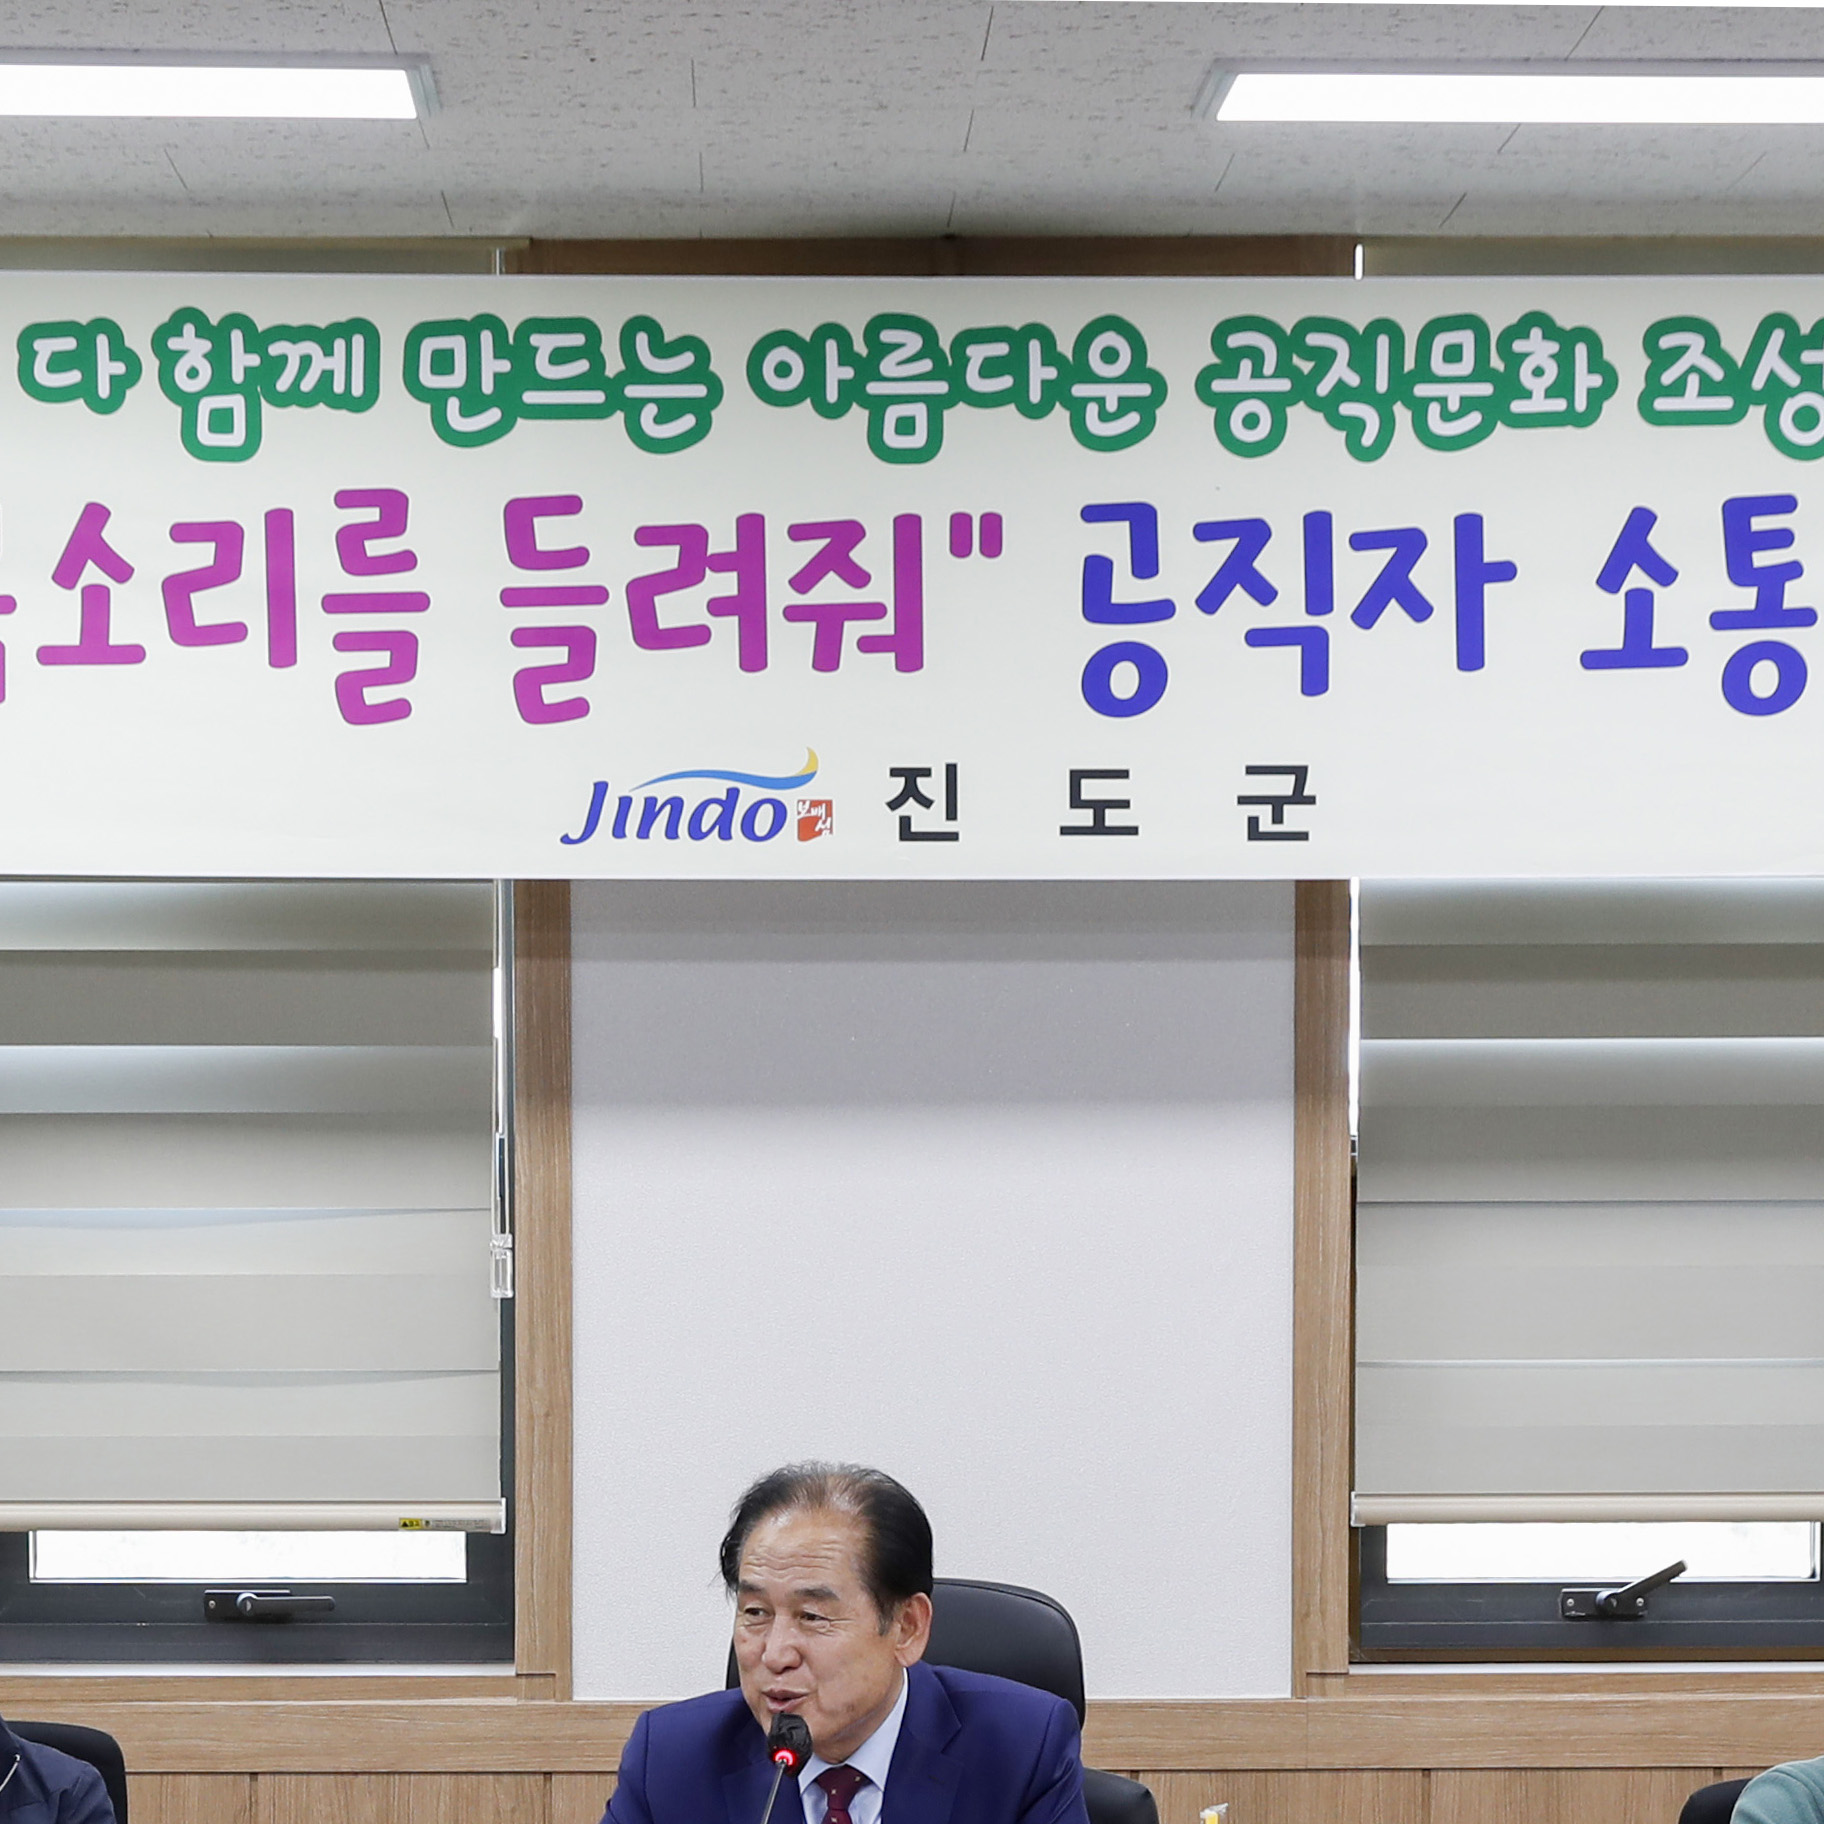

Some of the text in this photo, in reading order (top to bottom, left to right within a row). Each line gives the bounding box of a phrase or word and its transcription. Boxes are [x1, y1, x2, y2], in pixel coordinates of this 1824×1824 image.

[16, 316, 144, 417] 다
[150, 306, 382, 464] 함께
[402, 312, 725, 456] 만드는
[745, 312, 1169, 466] 아름다운
[1194, 310, 1620, 463] 공직문화
[499, 494, 1004, 726] 들려줘"
[1049, 500, 1519, 719] 공직자
[1579, 493, 1819, 717] 소통
[560, 780, 788, 846] Jindo
